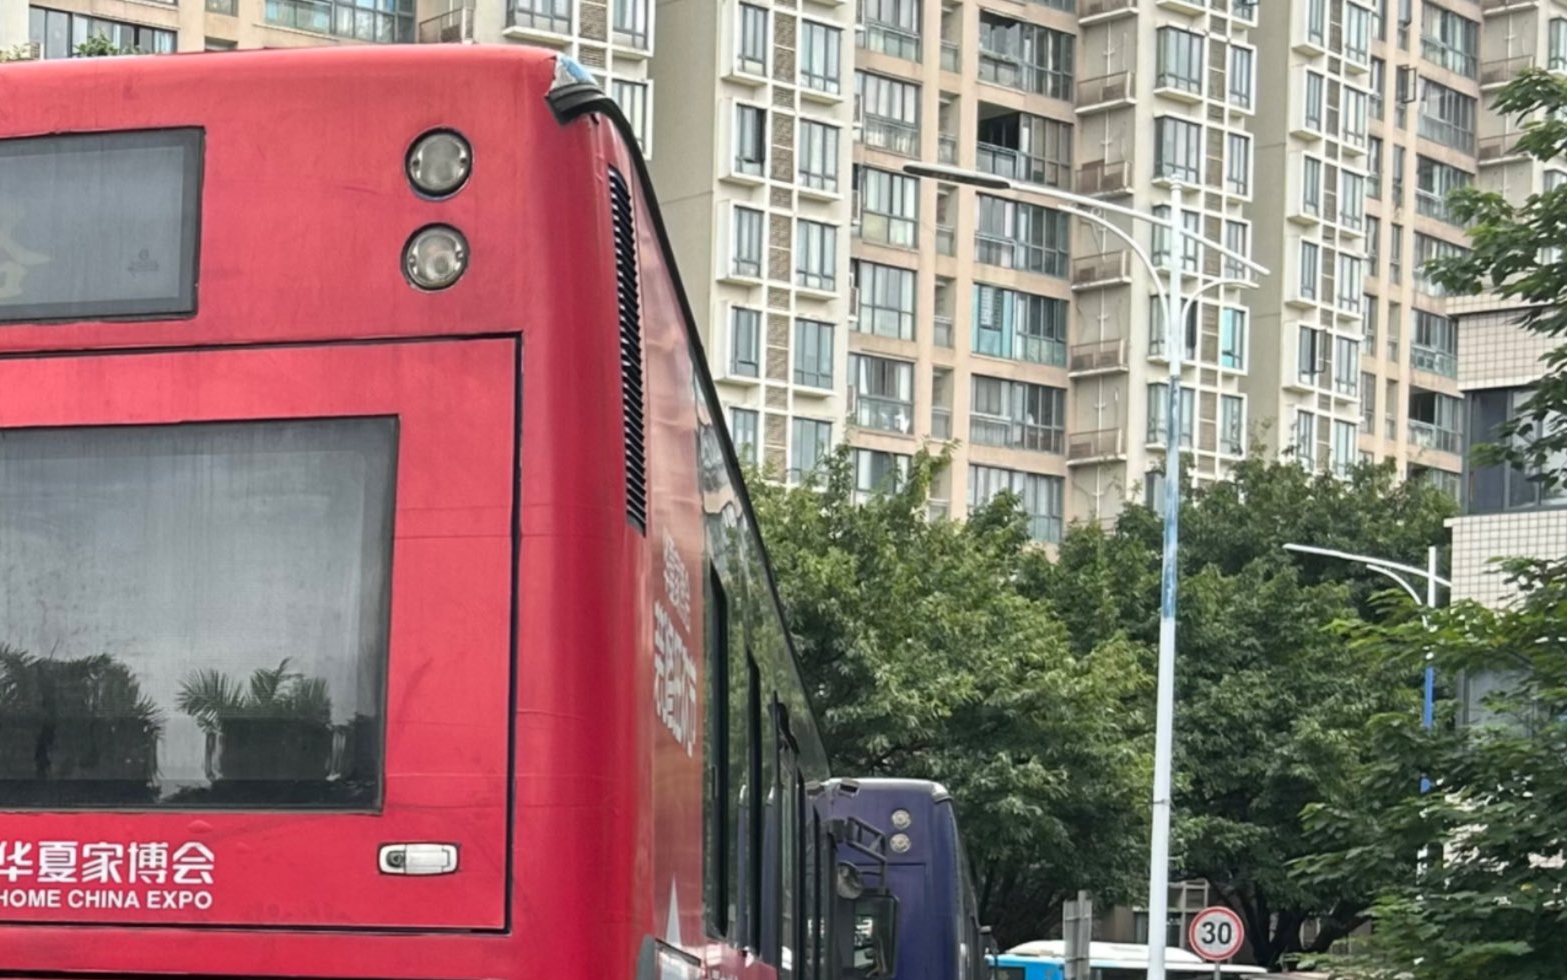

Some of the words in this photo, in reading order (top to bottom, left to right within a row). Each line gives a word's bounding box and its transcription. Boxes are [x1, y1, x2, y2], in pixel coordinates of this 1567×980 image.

[67, 889, 140, 910] CHINA
[146, 890, 213, 911] EXPO
[1201, 921, 1233, 945] 30
